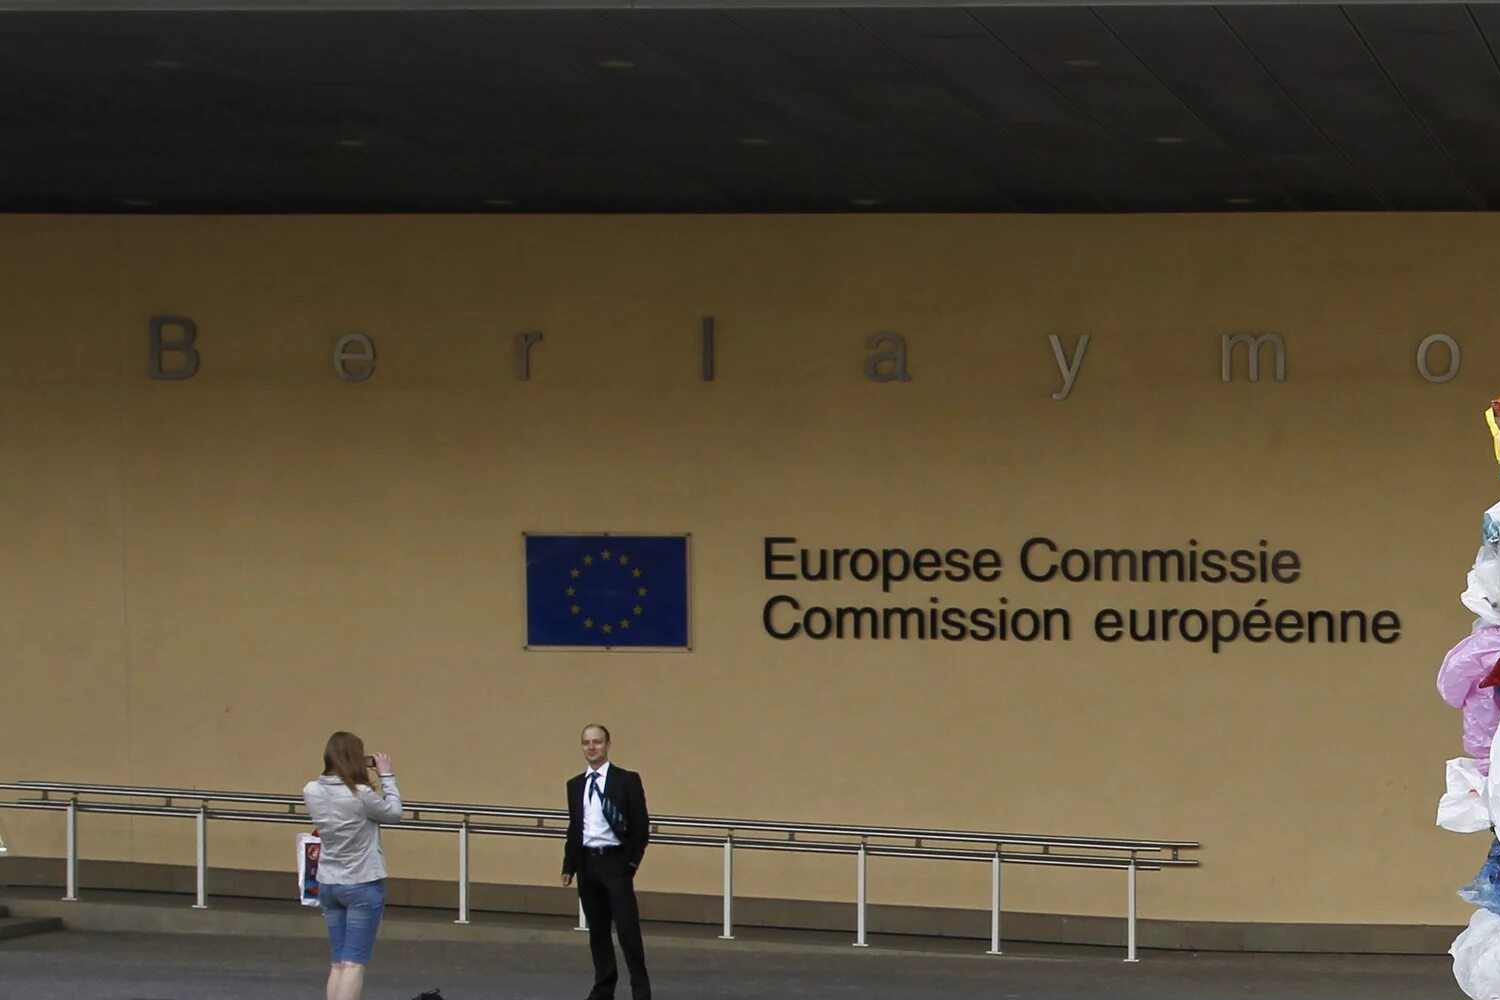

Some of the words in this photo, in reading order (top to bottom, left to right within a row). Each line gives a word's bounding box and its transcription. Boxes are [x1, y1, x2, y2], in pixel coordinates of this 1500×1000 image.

[763, 536, 1001, 592] Europese
[1019, 535, 1301, 584] Commissie
[762, 594, 1070, 642] Commission
[1094, 598, 1401, 653] européenne
